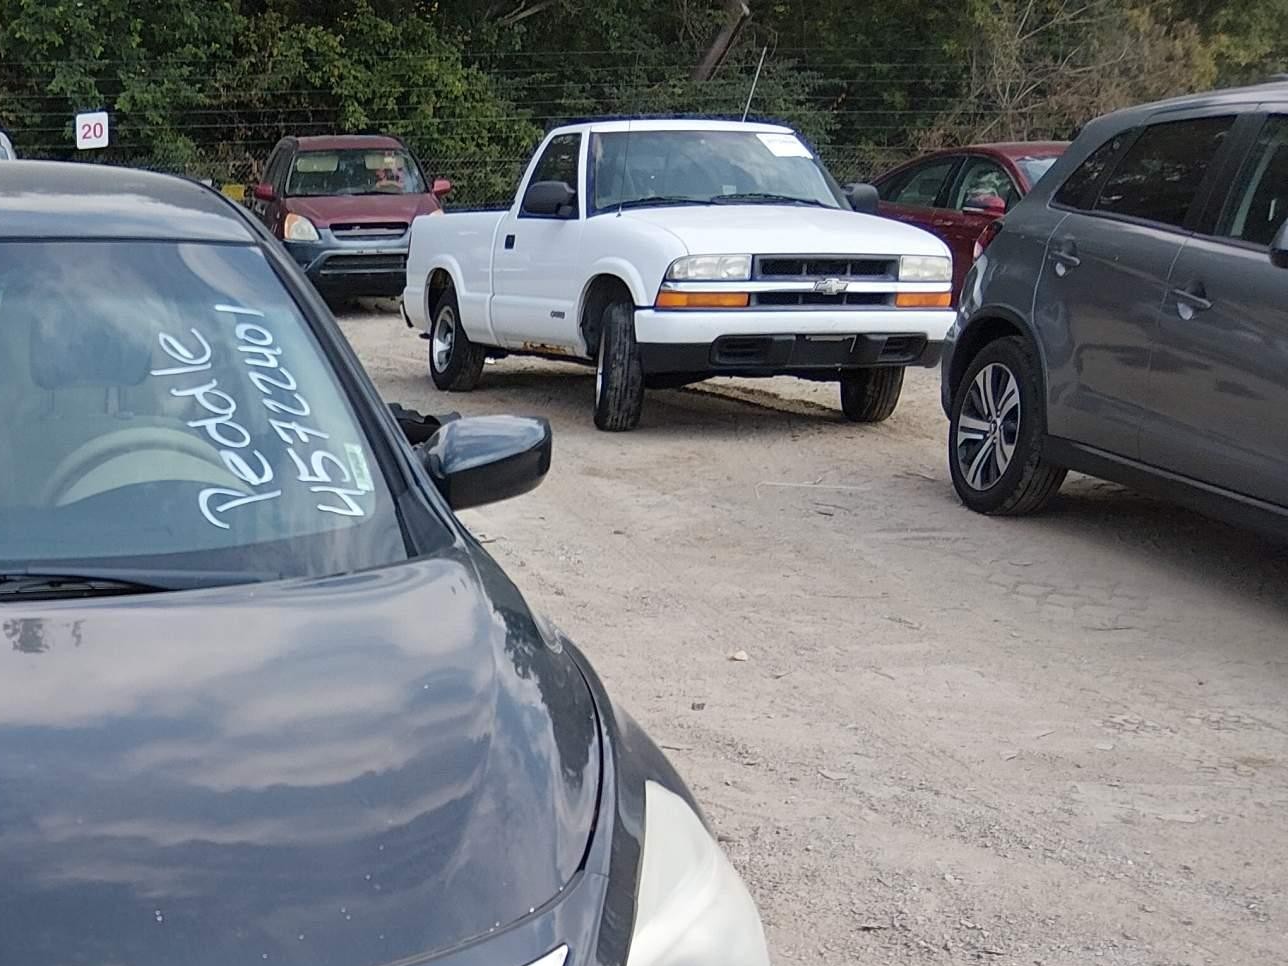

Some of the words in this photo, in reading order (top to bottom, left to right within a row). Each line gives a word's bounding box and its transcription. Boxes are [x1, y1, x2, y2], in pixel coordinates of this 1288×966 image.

[81, 122, 104, 140] 20
[151, 327, 282, 529] Peddle
[214, 304, 368, 518] 45722401
